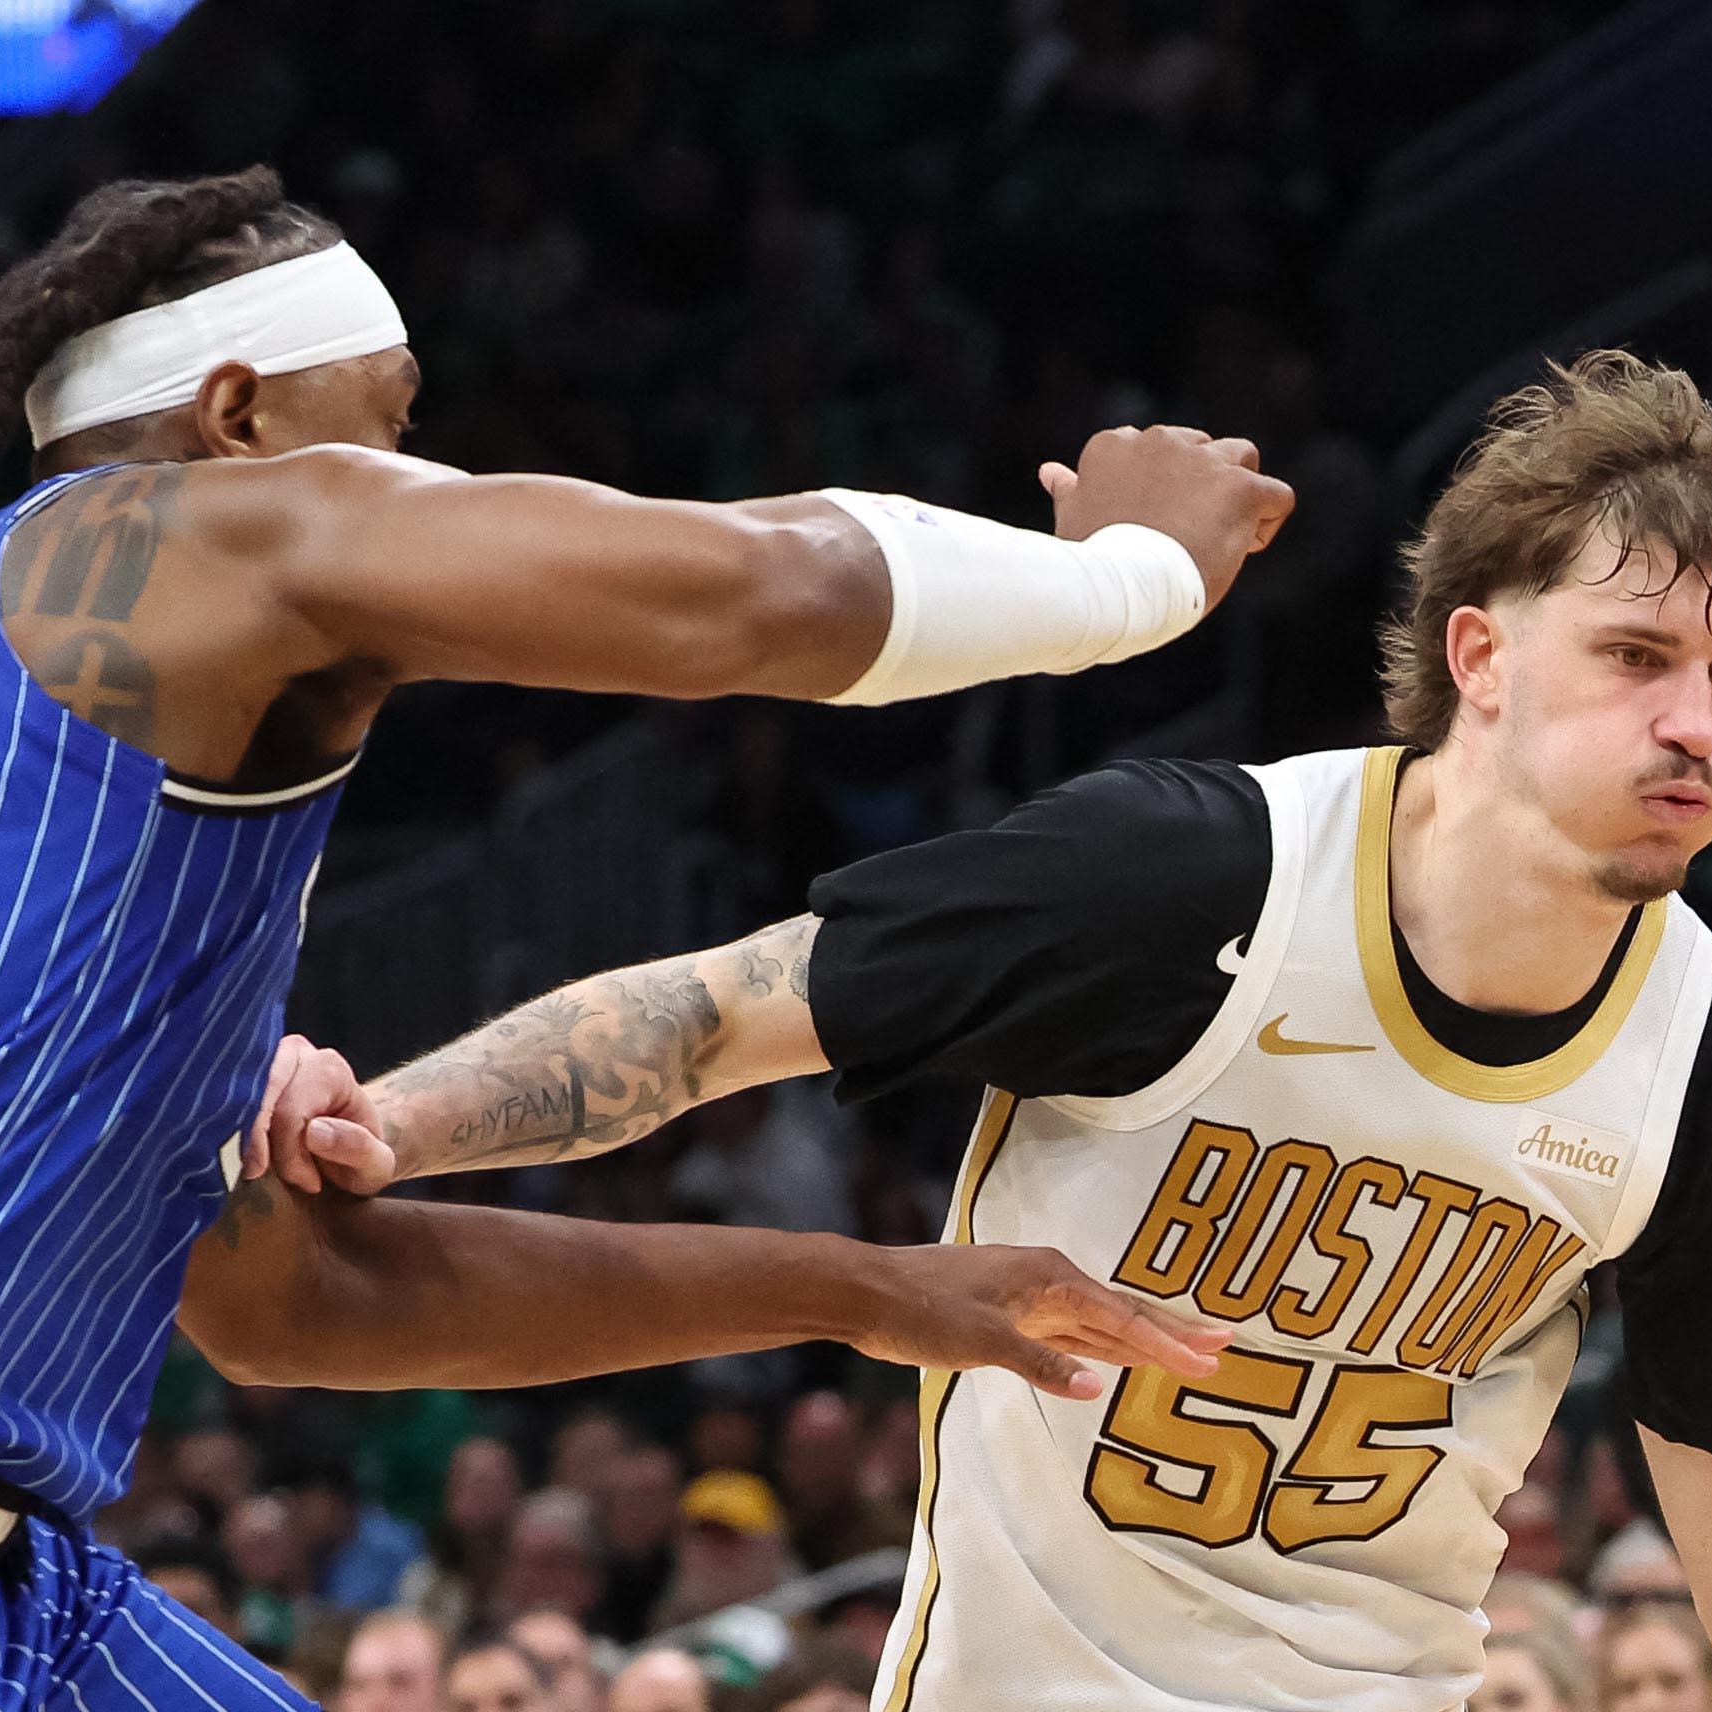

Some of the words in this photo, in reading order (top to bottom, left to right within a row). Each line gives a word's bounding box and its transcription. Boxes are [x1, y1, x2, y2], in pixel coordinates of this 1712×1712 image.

[1110, 1116, 1588, 1381] BOSTON
[1517, 1123, 1620, 1179] Amica
[1082, 1344, 1455, 1556] 55
